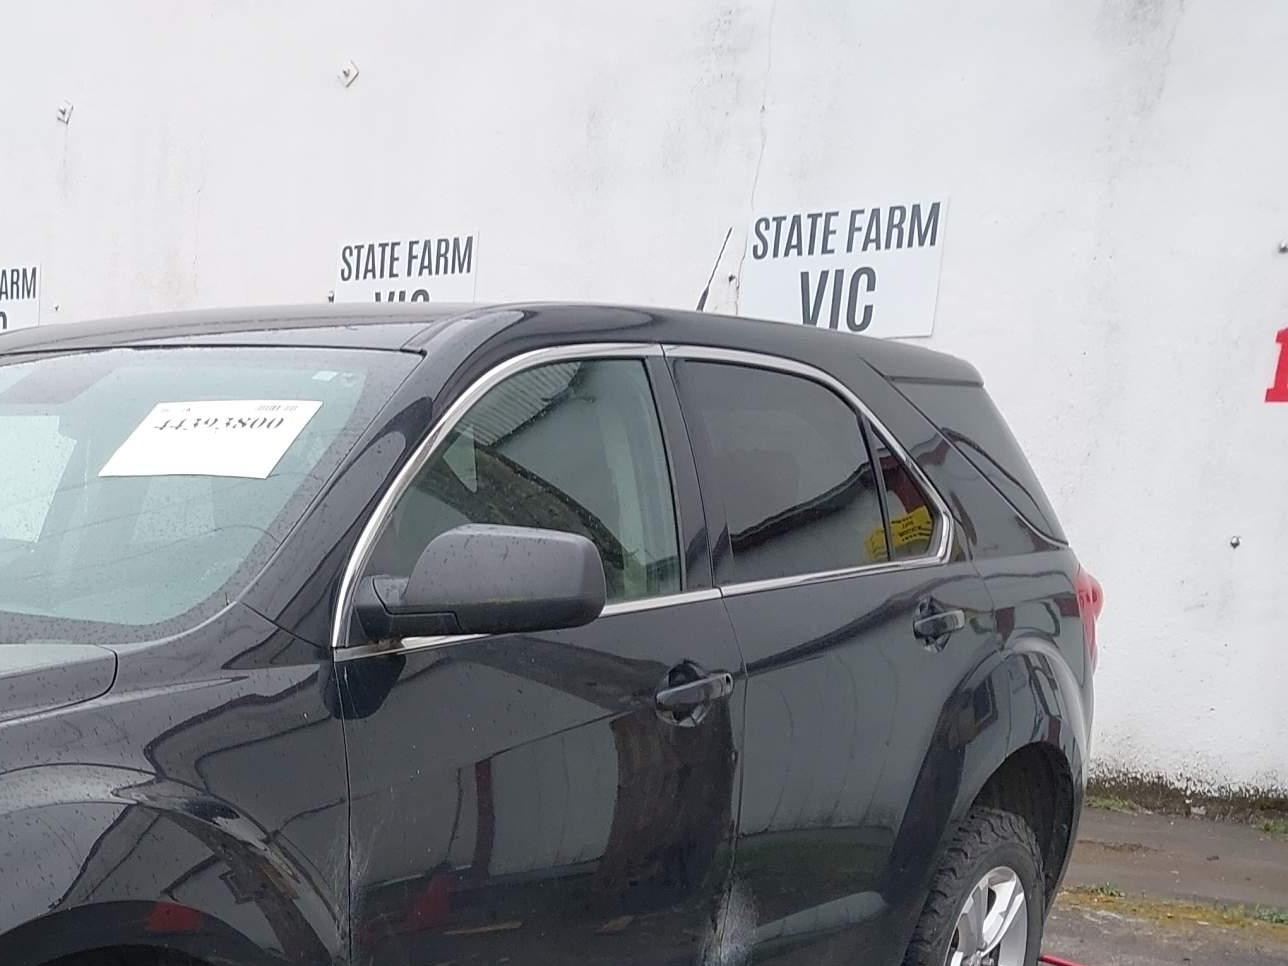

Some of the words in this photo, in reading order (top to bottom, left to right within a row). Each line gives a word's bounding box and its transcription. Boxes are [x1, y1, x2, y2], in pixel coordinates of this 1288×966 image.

[340, 241, 401, 282] STATE
[407, 236, 474, 277] FARM
[752, 210, 840, 260] STATE
[846, 201, 941, 253] FARM
[800, 266, 877, 332] VIC
